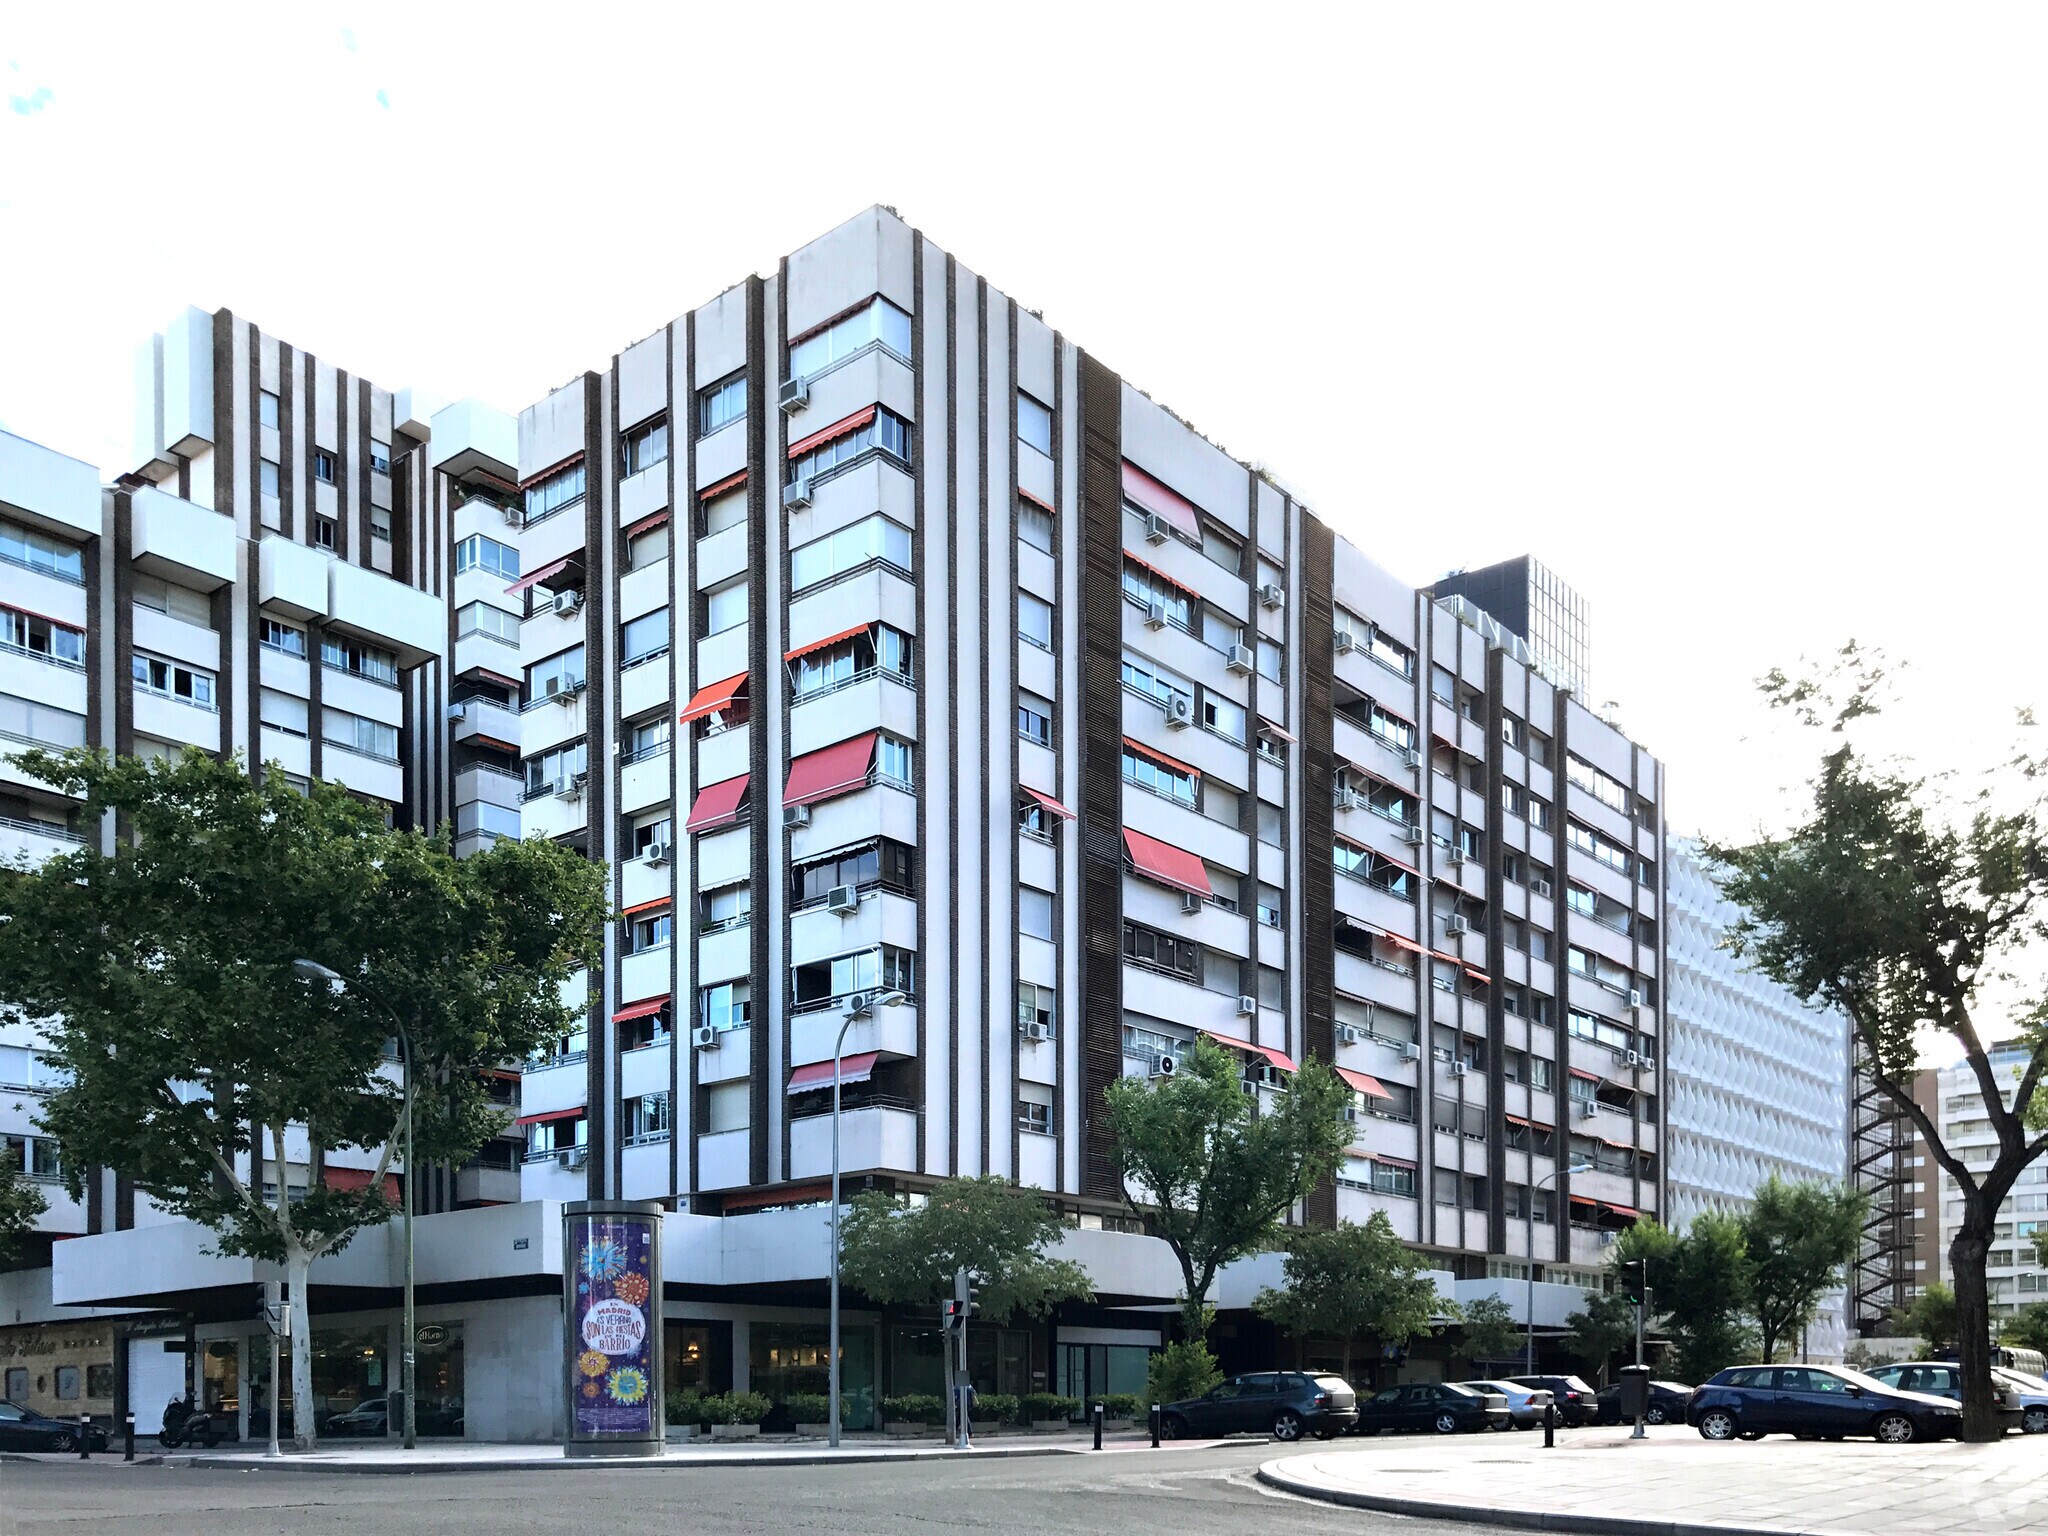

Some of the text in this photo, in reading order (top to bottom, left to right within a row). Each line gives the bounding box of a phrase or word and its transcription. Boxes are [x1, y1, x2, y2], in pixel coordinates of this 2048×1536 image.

[597, 1308, 631, 1316] MADRID
[597, 1315, 631, 1325] ES VERANO
[586, 1320, 641, 1340] SON LAS FIESTAS
[599, 1338, 631, 1350] BARRIO
